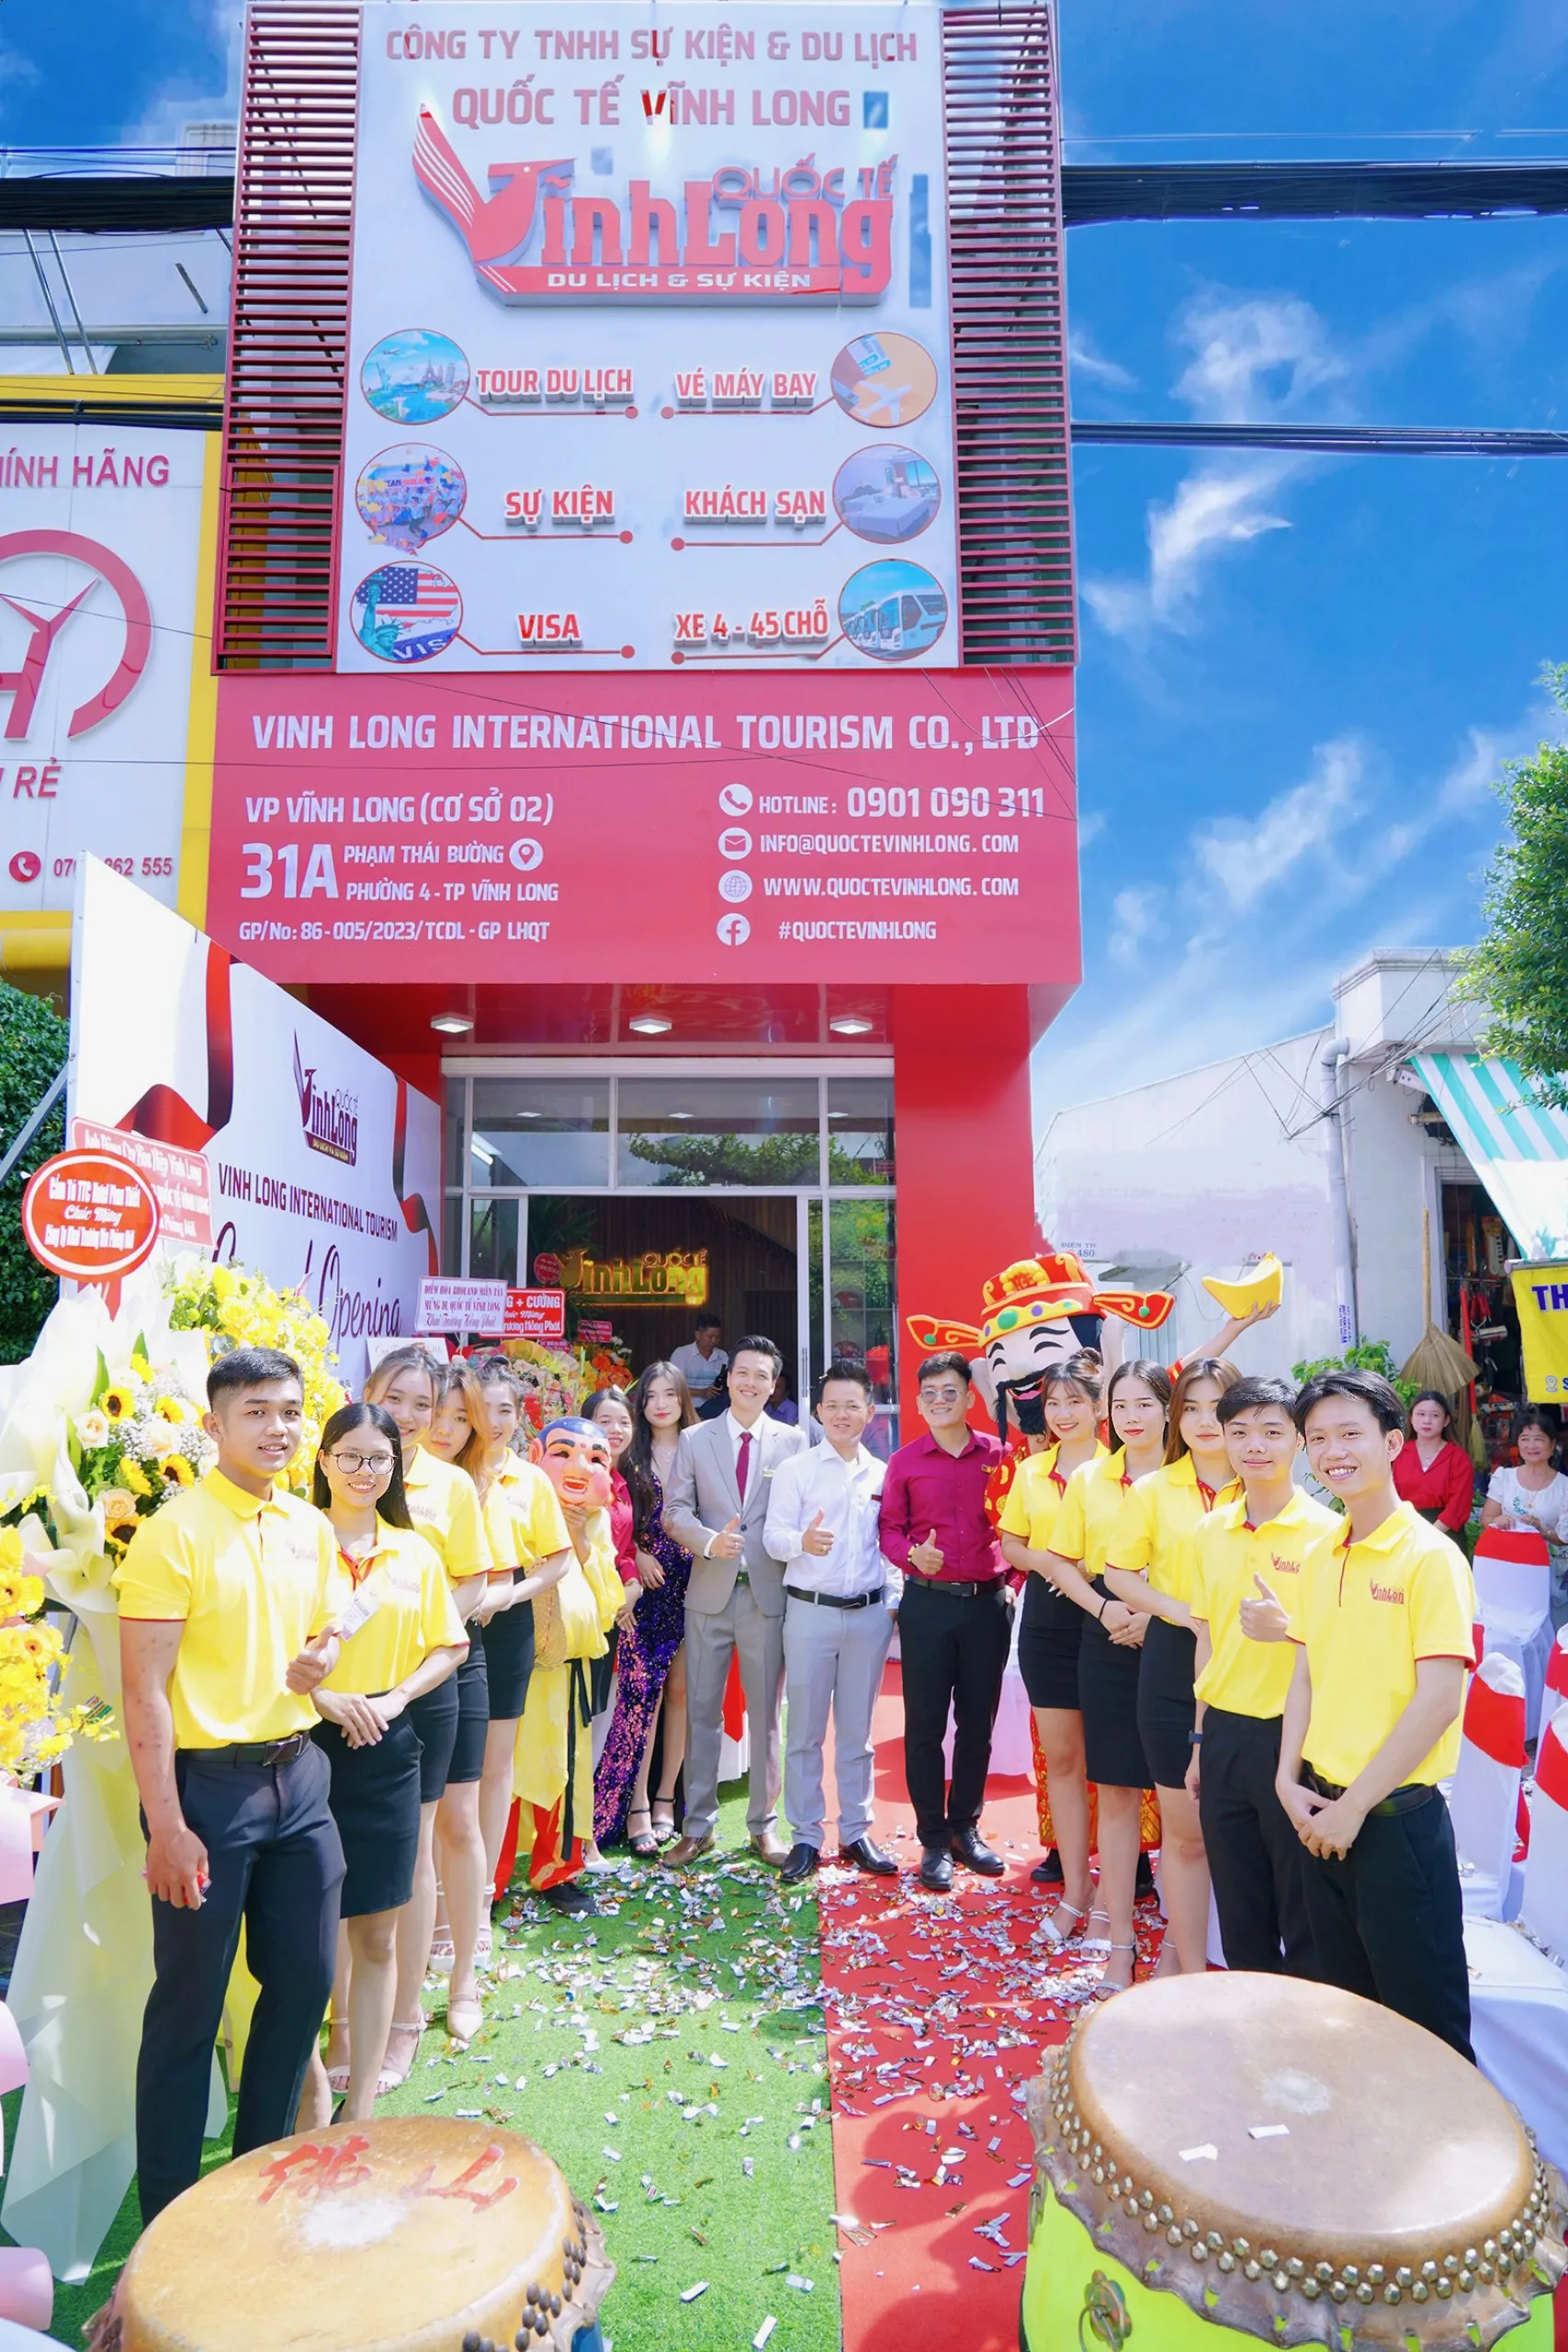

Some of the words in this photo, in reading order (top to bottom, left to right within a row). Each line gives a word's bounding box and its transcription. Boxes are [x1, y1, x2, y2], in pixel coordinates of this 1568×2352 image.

[387, 24, 467, 60] CÔNG
[478, 30, 518, 60] TY
[534, 30, 619, 60] TNHH
[630, 29, 671, 66] SỰ
[684, 24, 756, 67] KIỆN
[766, 30, 792, 61] &
[802, 31, 844, 61] DU
[854, 31, 917, 70] LỊCH
[452, 74, 555, 129] QUỐC
[573, 74, 626, 126] TẾ
[641, 82, 736, 126] VĨNH
[751, 89, 851, 127] LONG
[711, 153, 845, 204] QUỐC
[859, 154, 898, 200] TẾ
[547, 273, 586, 288] DU
[596, 273, 662, 292] LỊCH
[668, 273, 688, 288] &
[697, 273, 738, 291] SỰ
[743, 270, 811, 291] KIỆN
[476, 368, 540, 395] TOUR
[546, 369, 581, 395] DU
[583, 368, 633, 401] LỊCH
[676, 366, 705, 399] VÉ
[713, 366, 764, 399] MÁY
[772, 372, 817, 399] BAY
[0, 447, 59, 486] ÍNH
[73, 447, 170, 487] HÃNG
[504, 489, 543, 525] SỰ
[552, 482, 615, 524] KIỆN
[684, 487, 767, 516] KHÁCH
[775, 489, 827, 524] SẠN
[517, 615, 581, 639] VISA
[674, 613, 706, 639] XE
[712, 614, 729, 638] 4
[749, 613, 781, 639] 45
[784, 598, 829, 639] CHỖ
[253, 715, 333, 749] VINH
[349, 715, 436, 749] LONG
[452, 715, 722, 750] INTERNATIONAL
[736, 715, 893, 750] TOURISM
[13, 756, 62, 798] RẺ
[245, 797, 280, 823] VP
[287, 790, 344, 822] VĨNH
[352, 797, 415, 823] LONG
[420, 792, 462, 825] (CƠ
[468, 786, 502, 822] SỞ
[509, 793, 555, 825] 02)
[847, 786, 919, 818] 0901
[930, 787, 989, 818] 090
[998, 787, 1043, 818] 311
[53, 858, 77, 877] 07
[141, 857, 173, 876] 555
[239, 842, 340, 899] 31A
[344, 845, 395, 868] PHẠM
[401, 842, 440, 864] THÁI
[447, 840, 504, 865] BƯỜNG
[345, 877, 414, 901] PHƯỜNG
[471, 879, 512, 901] VĨNH
[517, 883, 559, 901] LONG
[507, 922, 550, 941] LHQT
[778, 922, 937, 941] #QUOCTEVINHLONG
[64, 1204, 93, 1222] Chúc
[219, 1162, 252, 1202] VINH
[254, 1174, 287, 1211] LONG
[289, 1185, 364, 1232] INTERNATIONAL
[366, 1210, 399, 1242] TOURISM
[526, 1294, 561, 1309] CƯỜNG
